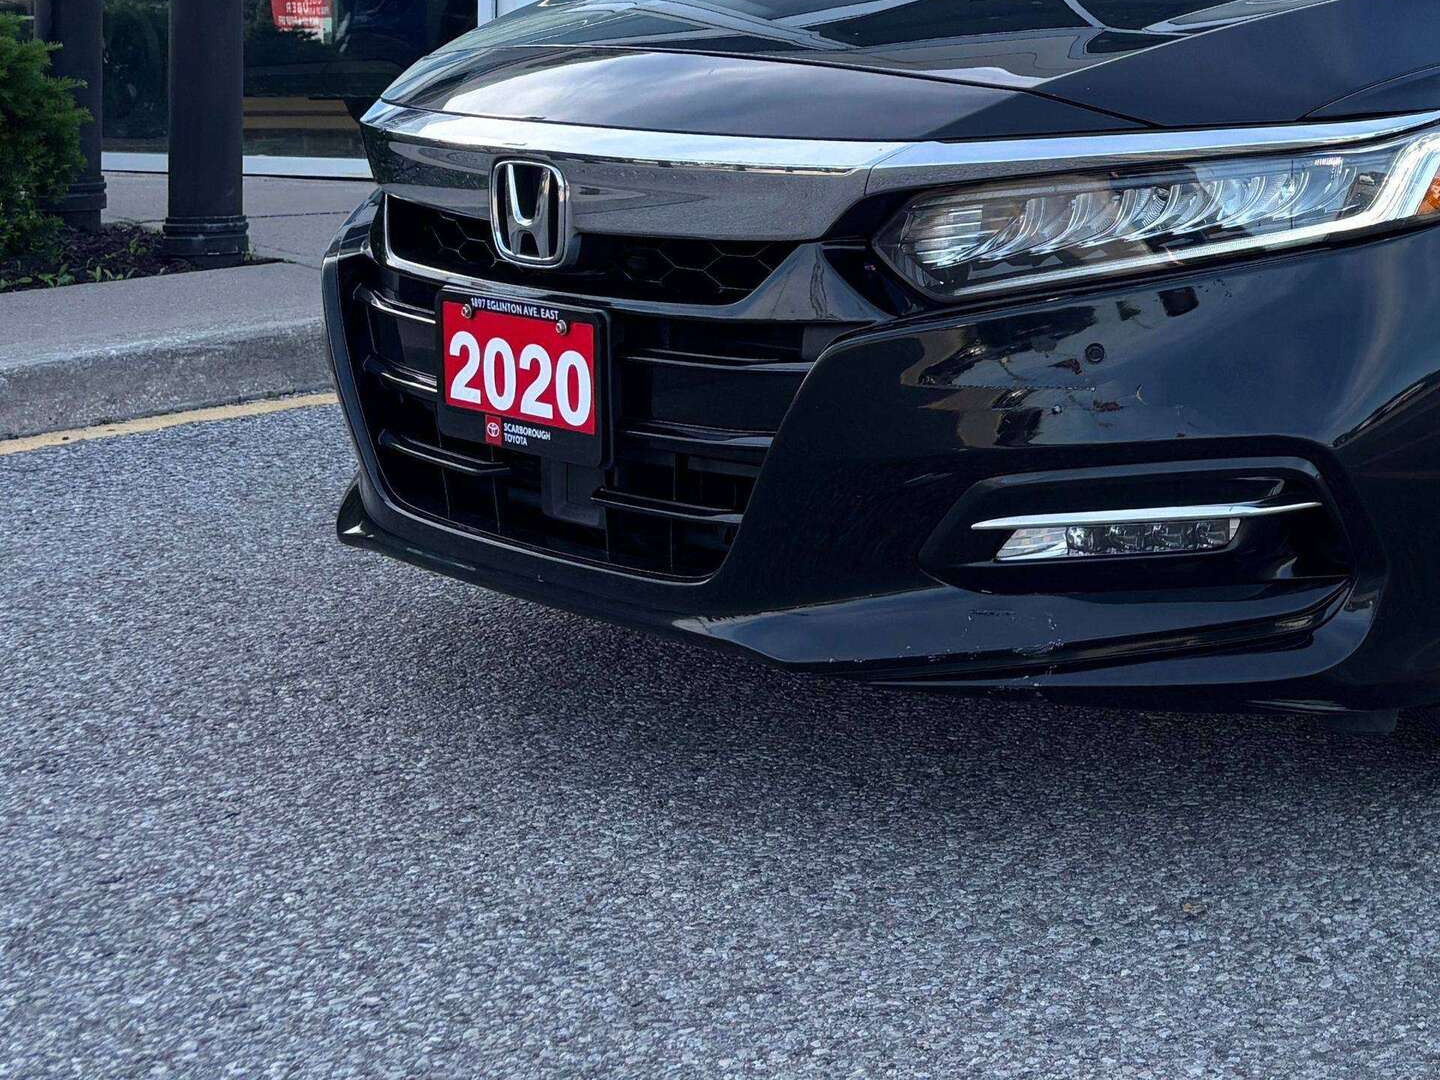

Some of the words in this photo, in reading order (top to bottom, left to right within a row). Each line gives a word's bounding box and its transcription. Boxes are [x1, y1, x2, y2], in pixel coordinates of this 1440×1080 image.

[471, 297, 486, 309] 1897
[487, 300, 522, 315] EGLINTON
[540, 308, 560, 321] EAST
[449, 331, 592, 427] 2020
[503, 422, 551, 441] SCARBOROUGH
[503, 432, 528, 446] TOYOTA
